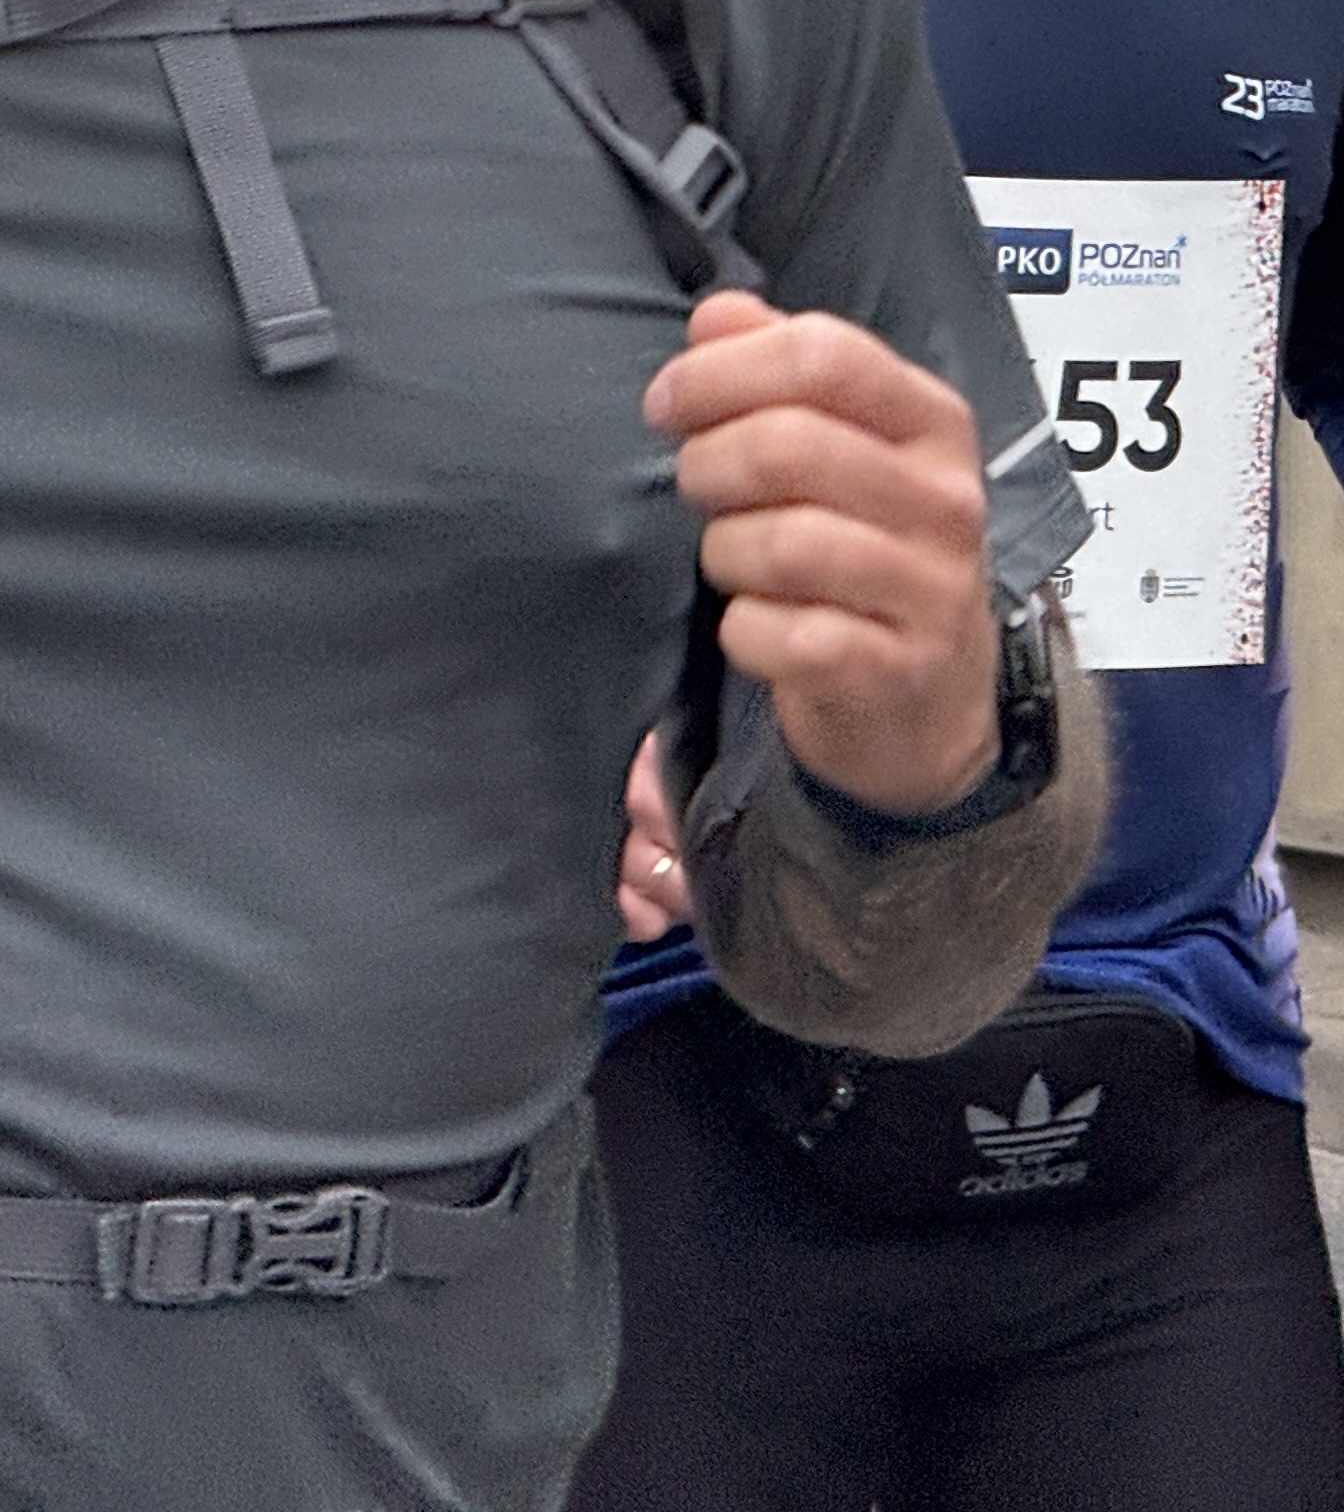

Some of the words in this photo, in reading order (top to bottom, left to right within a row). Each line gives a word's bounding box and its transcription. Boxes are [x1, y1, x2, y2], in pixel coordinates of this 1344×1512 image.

[1221, 73, 1265, 121] 23
[998, 245, 1063, 276] PKO
[1077, 272, 1182, 287] PÓŁMARATON
[1056, 360, 1183, 473] 53
[959, 1161, 1090, 1197] adidas
